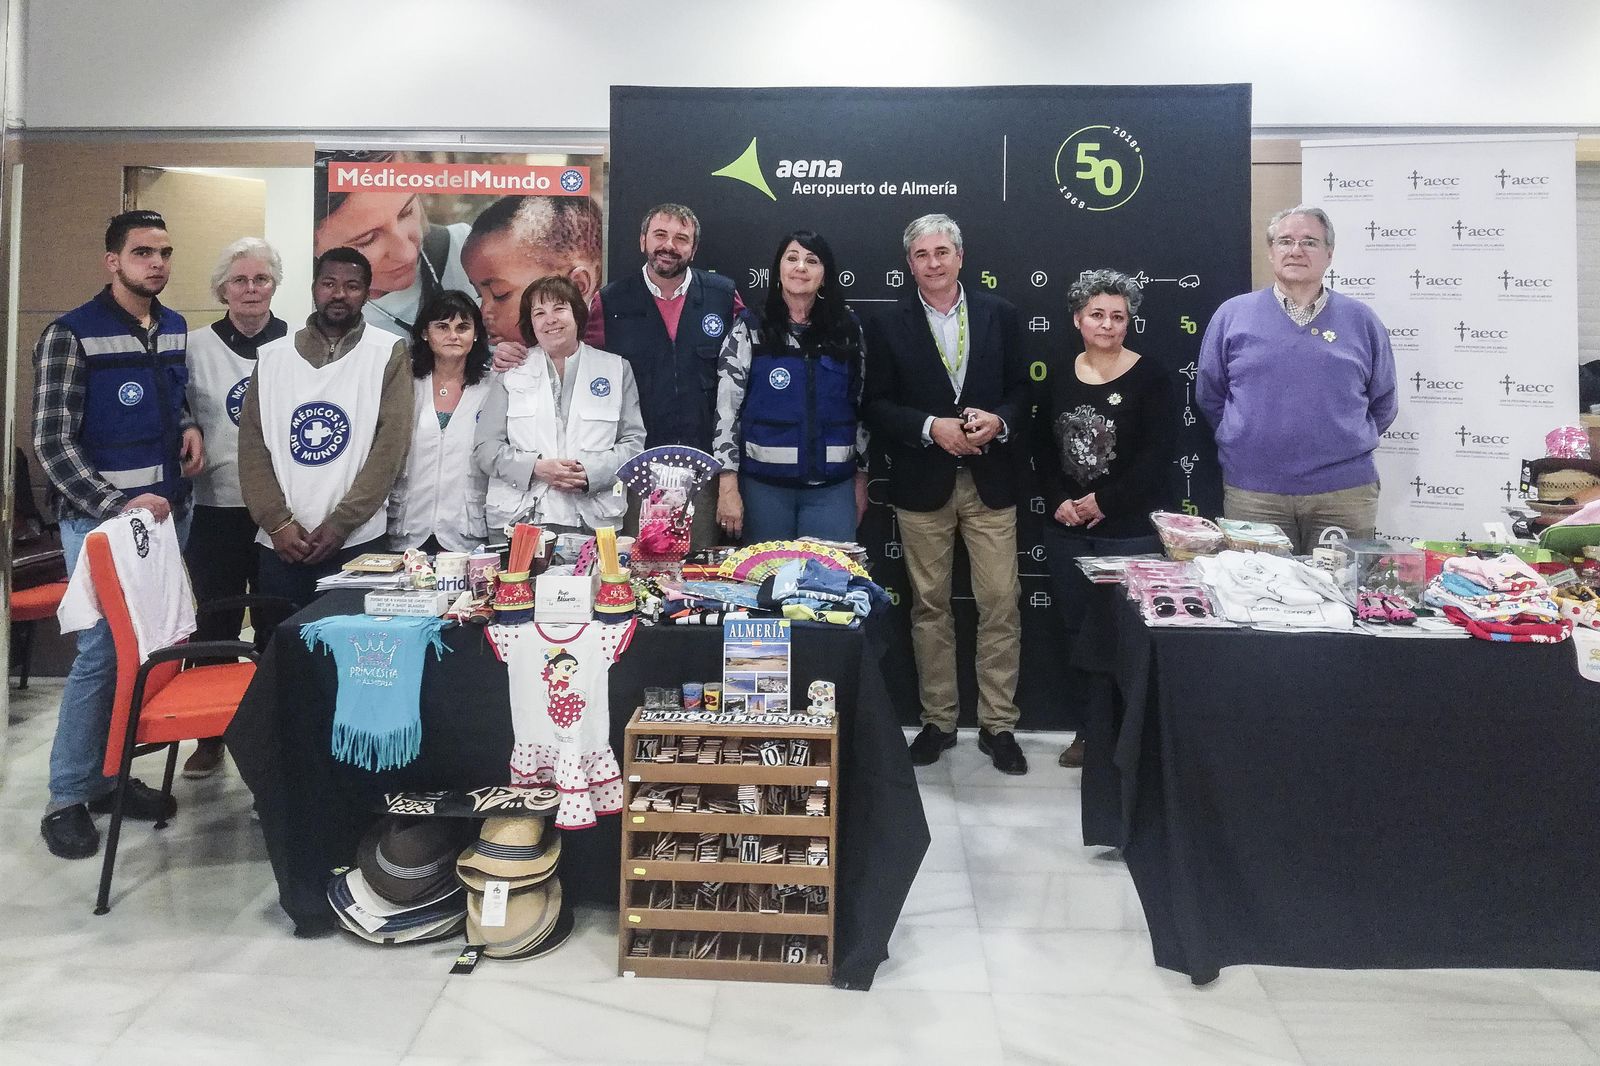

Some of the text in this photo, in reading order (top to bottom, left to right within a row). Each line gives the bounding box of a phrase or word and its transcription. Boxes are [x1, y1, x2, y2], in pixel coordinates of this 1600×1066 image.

[1113, 126, 1138, 148] 2018
[776, 158, 843, 178] aena
[1076, 142, 1123, 196] 50
[1339, 178, 1374, 188] aecc
[1424, 177, 1460, 186] aecc
[1511, 175, 1550, 186] aecc
[792, 180, 958, 198] Aeropuerto de Almería
[1059, 185, 1086, 209] 1968
[1381, 227, 1417, 237] aecc
[1468, 227, 1505, 237] aecc
[1340, 277, 1376, 286] aecc
[1426, 276, 1463, 286] aecc
[1515, 277, 1553, 288] aecc
[1471, 329, 1509, 339] aecc
[1426, 379, 1464, 390] aecc
[1516, 382, 1554, 393] aecc
[1471, 433, 1510, 444] aecc
[290, 434, 343, 461] DEL MUNDO
[1427, 485, 1464, 496] aecc
[728, 620, 785, 638] ALMERÍA
